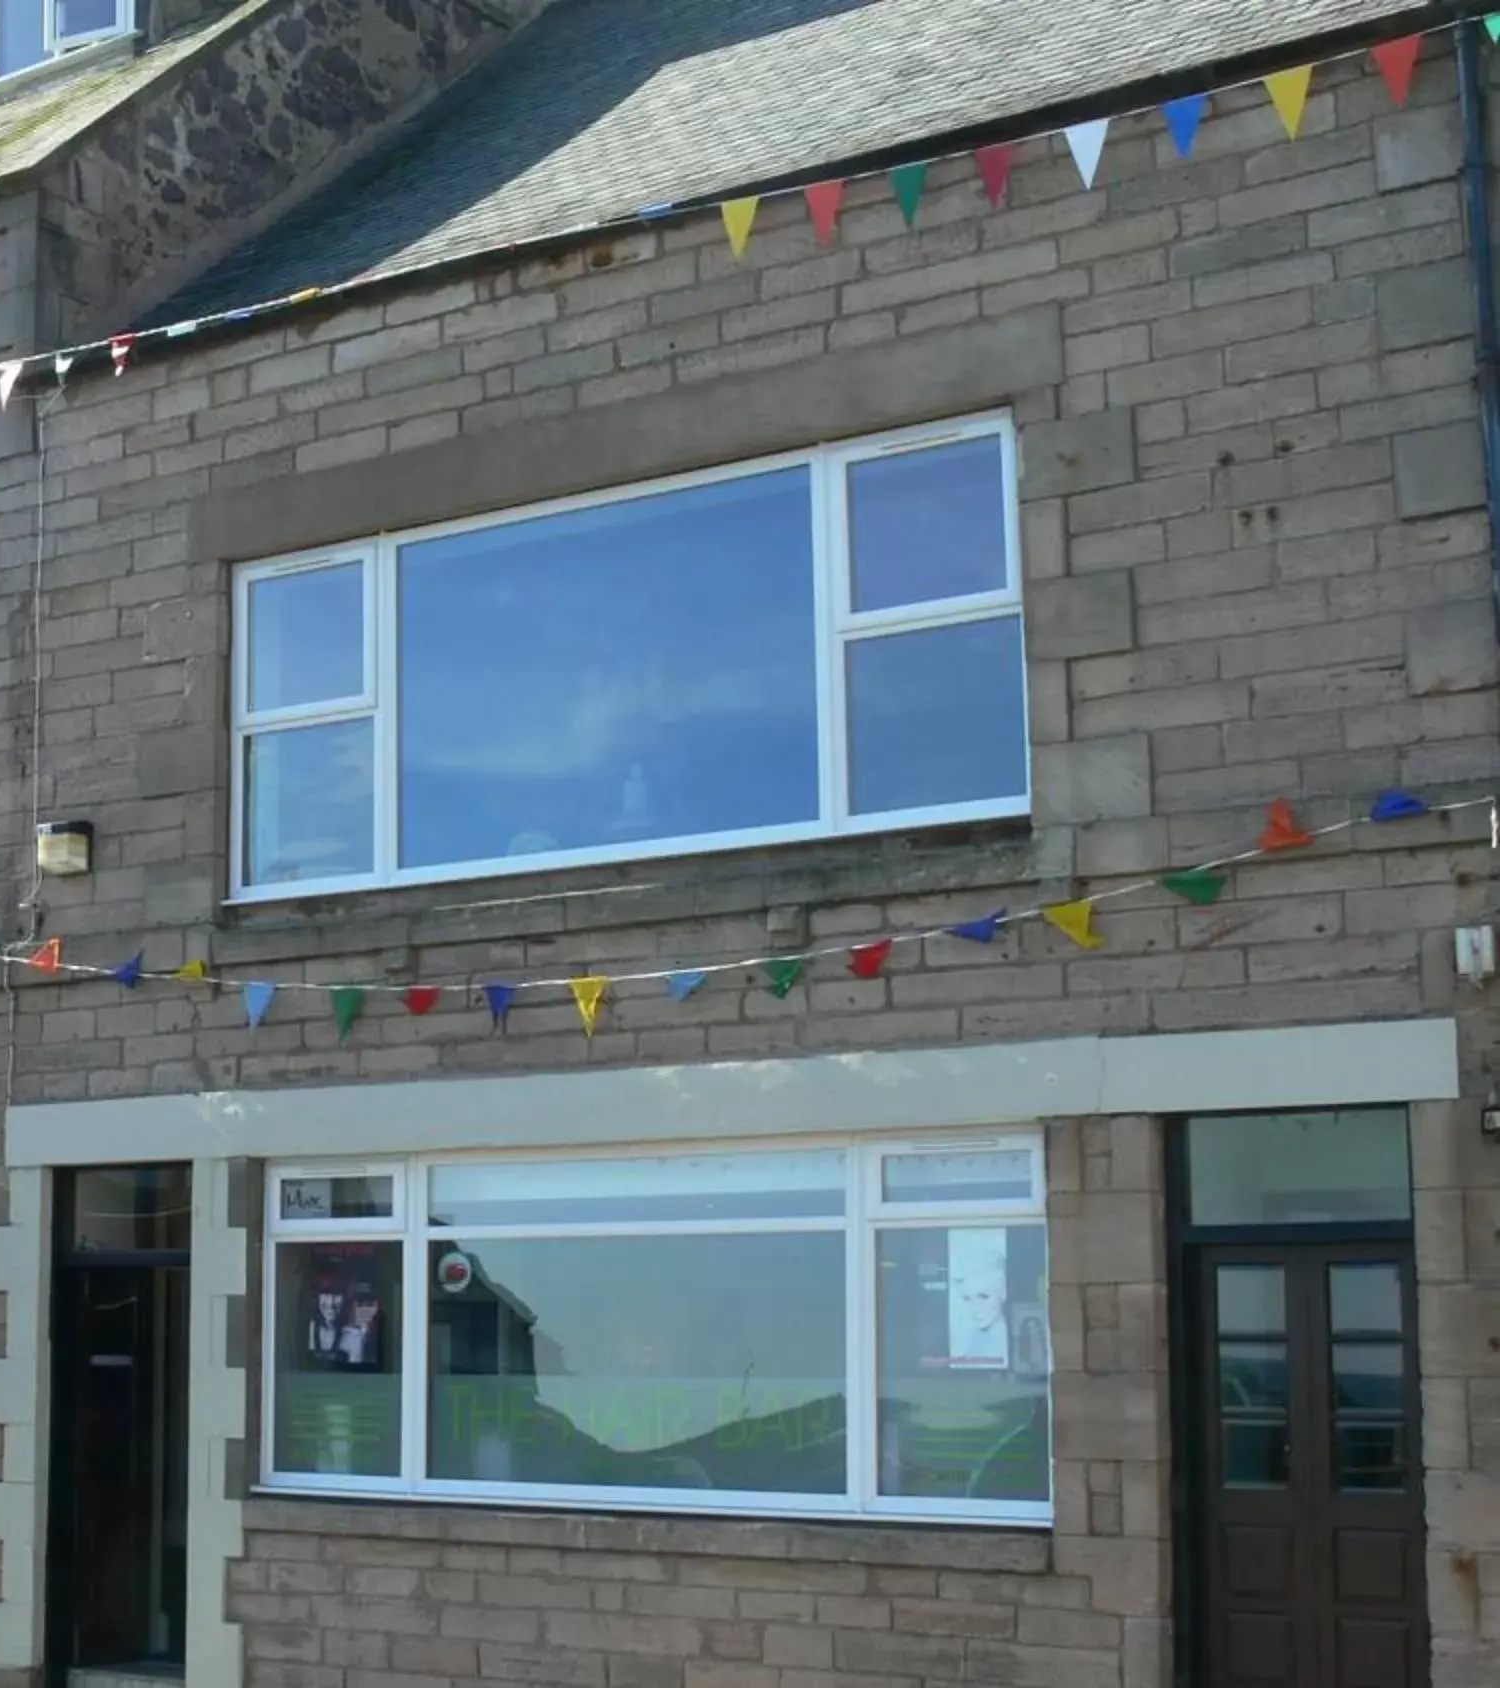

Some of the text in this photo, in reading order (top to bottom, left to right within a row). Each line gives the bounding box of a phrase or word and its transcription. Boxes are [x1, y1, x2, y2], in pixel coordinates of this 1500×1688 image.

[448, 1384, 832, 1452] THE HAIR BAR
